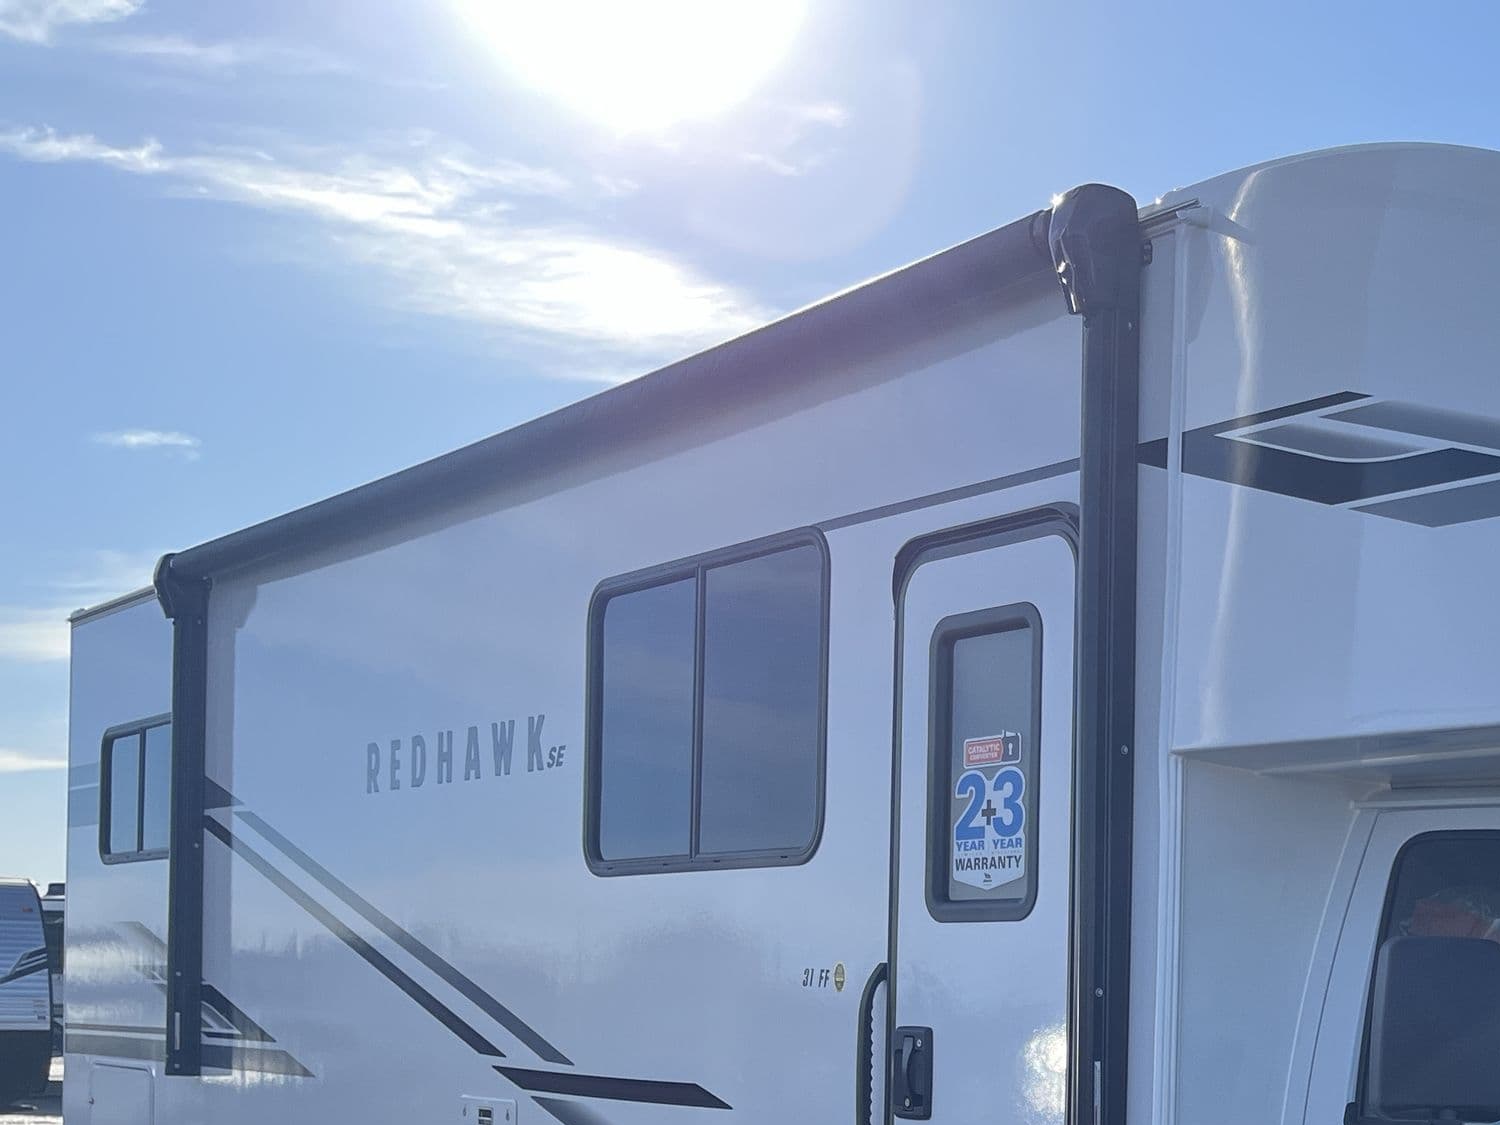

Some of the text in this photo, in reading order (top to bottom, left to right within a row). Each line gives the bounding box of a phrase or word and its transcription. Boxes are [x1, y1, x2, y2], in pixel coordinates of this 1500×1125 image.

[366, 714, 566, 794] REDHAWK SE
[956, 837, 1022, 851] YEAR YEAR
[955, 855, 1022, 871] WARRANTY
[818, 969, 830, 988] FF
